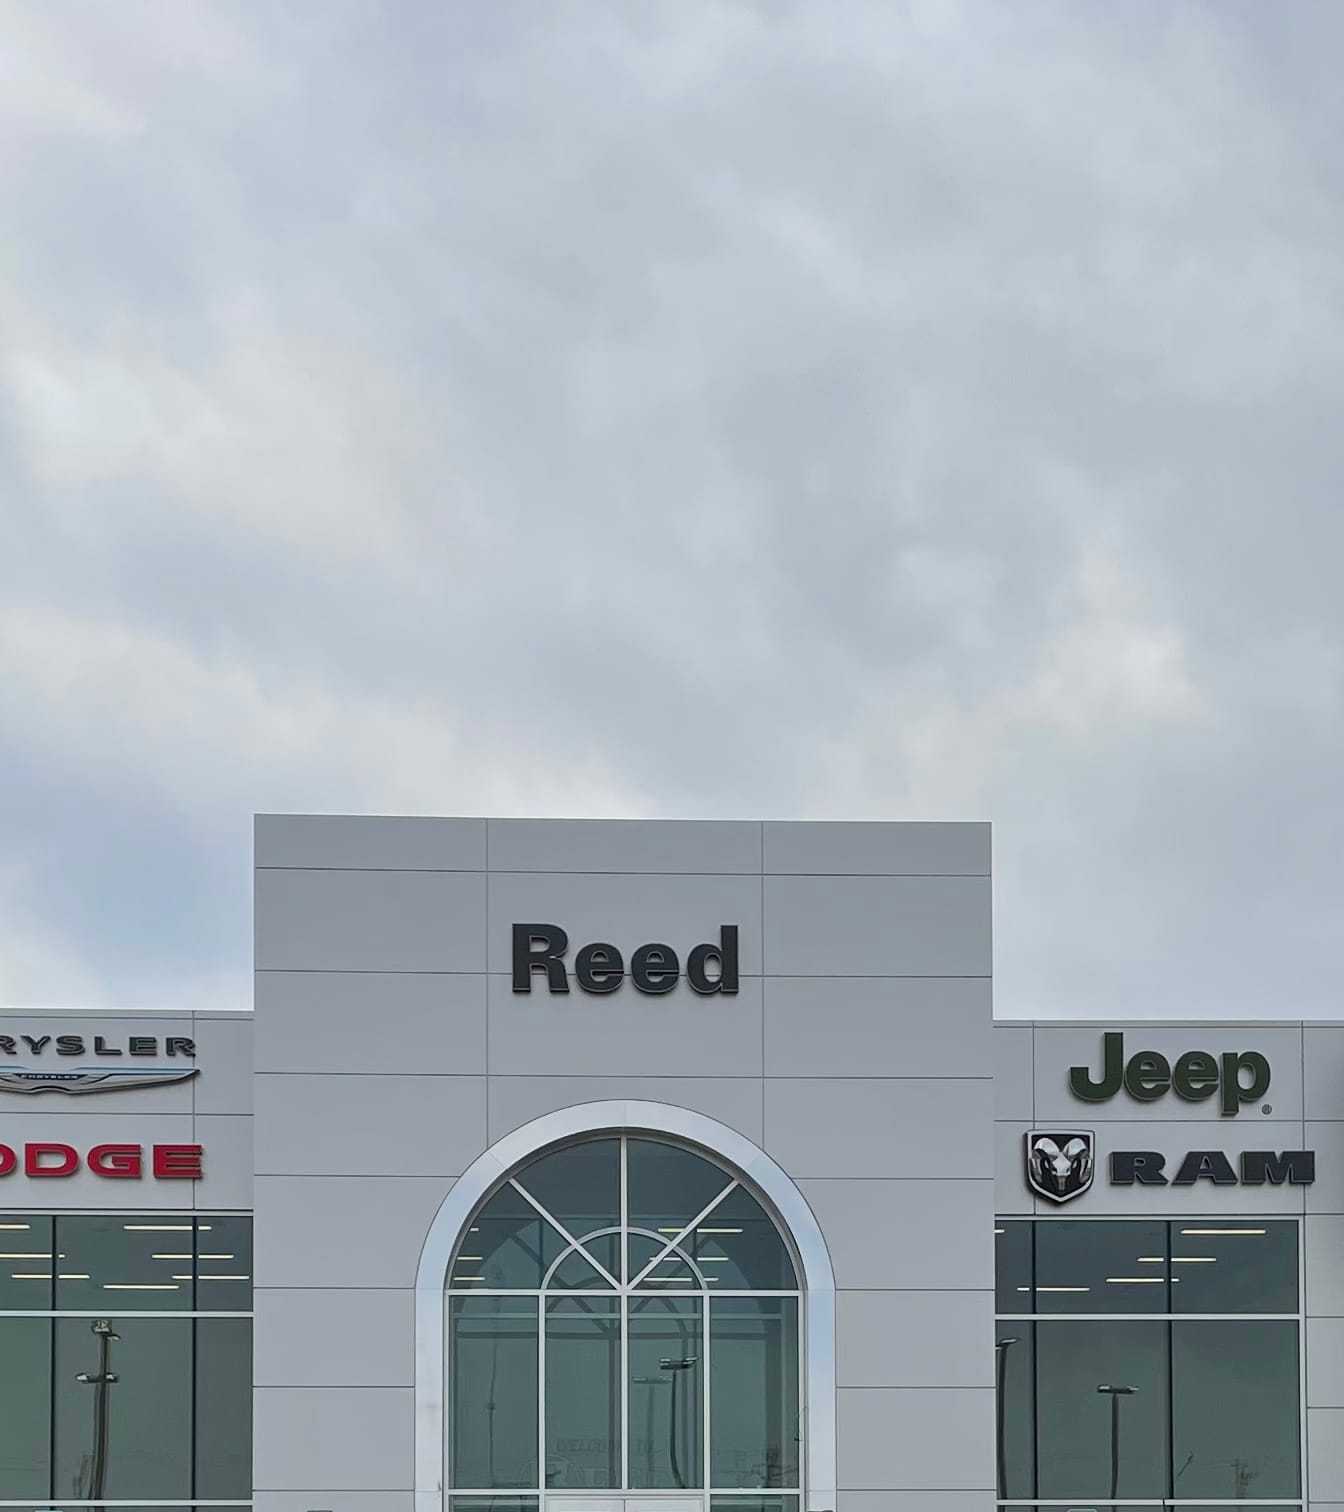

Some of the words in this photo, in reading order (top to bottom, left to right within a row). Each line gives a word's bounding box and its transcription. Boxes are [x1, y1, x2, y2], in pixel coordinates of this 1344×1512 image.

[511, 922, 739, 995] Reed
[1067, 1031, 1272, 1117] Jeep
[1109, 1151, 1316, 1186] RAM
